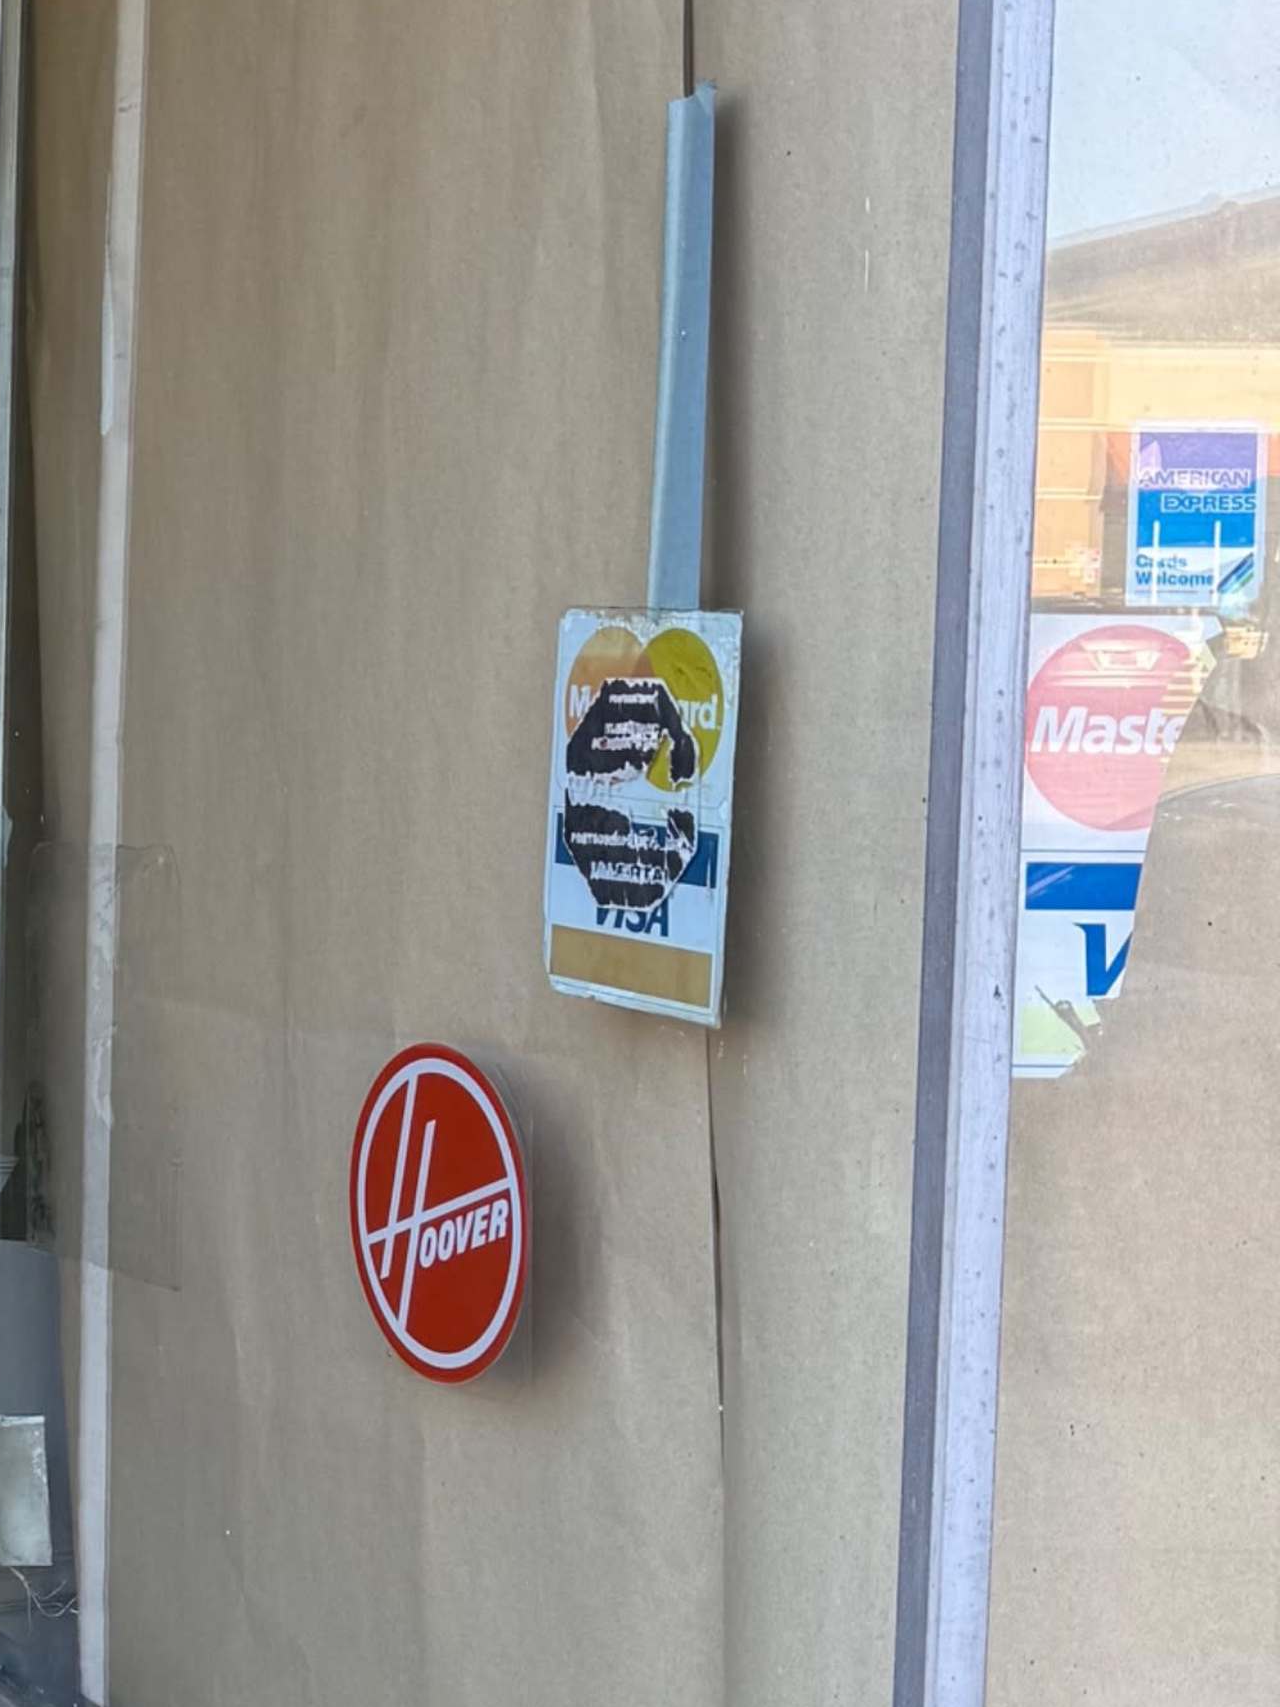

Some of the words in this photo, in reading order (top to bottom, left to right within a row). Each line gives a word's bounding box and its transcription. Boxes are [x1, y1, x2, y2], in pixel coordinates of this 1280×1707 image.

[1139, 469, 1249, 487] AMERICAN
[1163, 495, 1257, 511] EXPRESS
[1135, 572, 1214, 588] Wlcome
